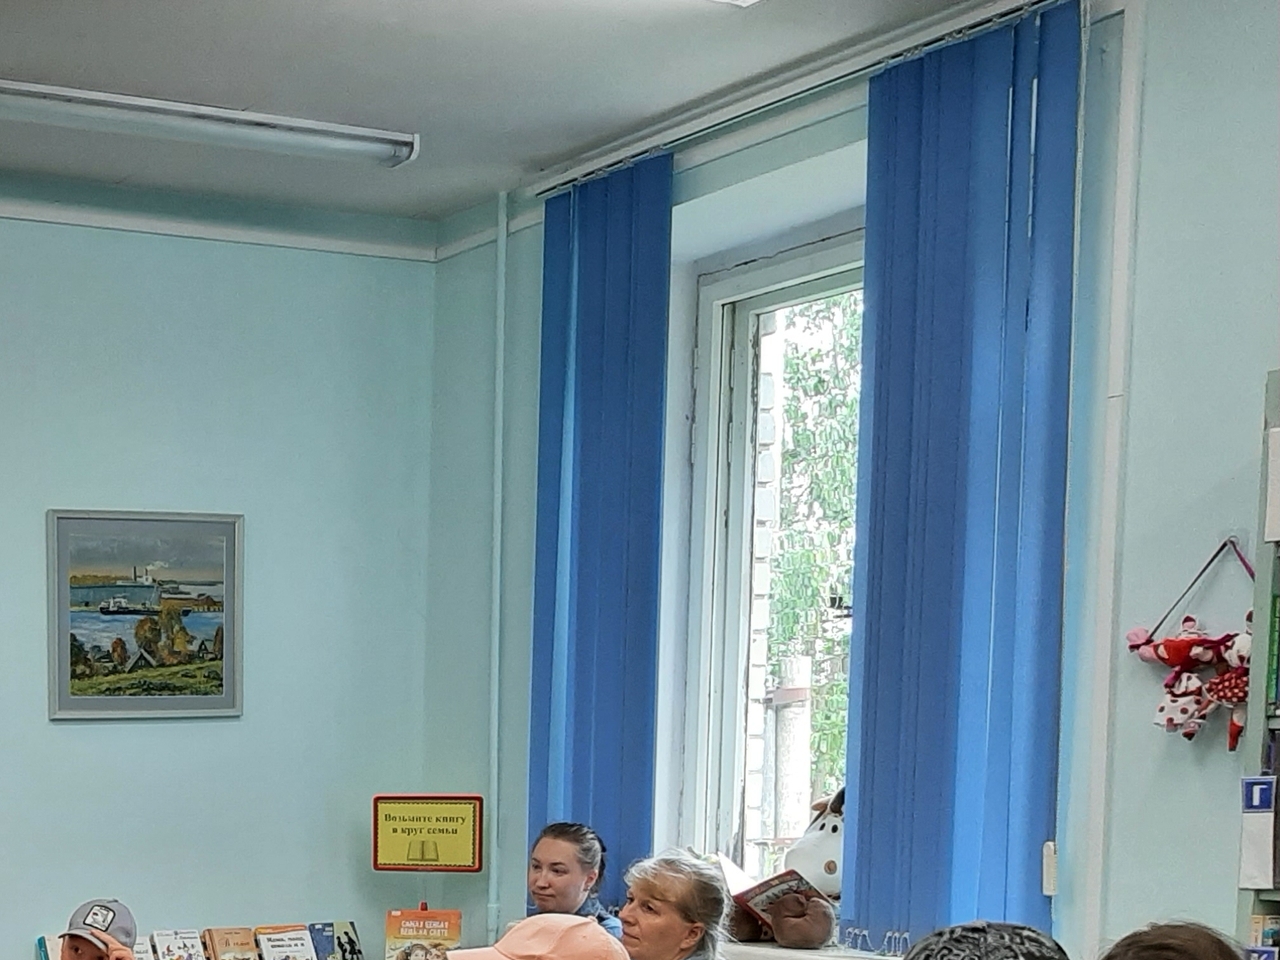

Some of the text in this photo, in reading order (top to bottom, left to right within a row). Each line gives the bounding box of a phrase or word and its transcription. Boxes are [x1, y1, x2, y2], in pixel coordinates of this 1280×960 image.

[1252, 784, 1268, 806] Г
[384, 813, 467, 826] Возьмите книгу
[391, 826, 459, 837] в круг семьи
